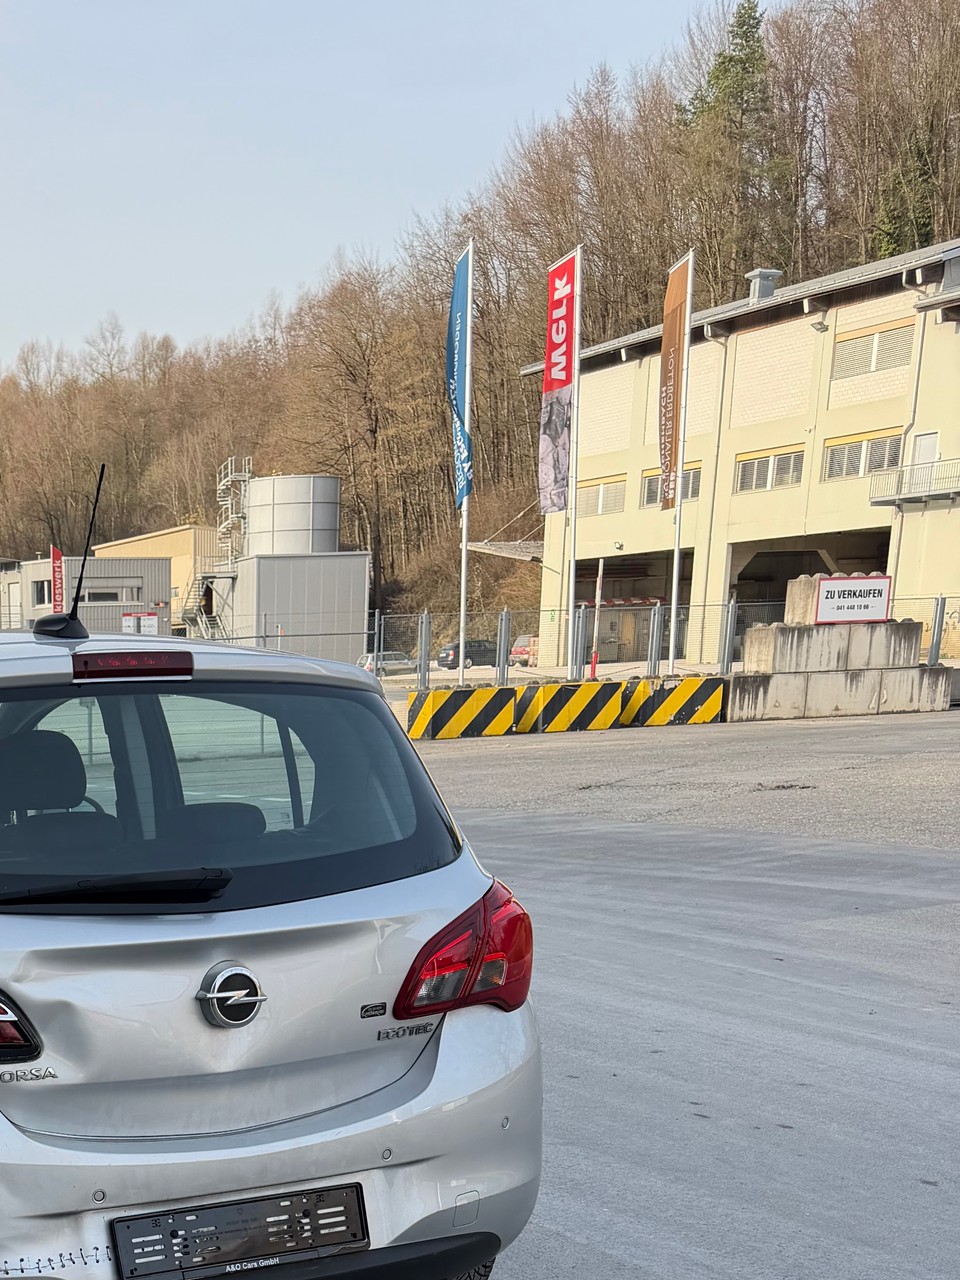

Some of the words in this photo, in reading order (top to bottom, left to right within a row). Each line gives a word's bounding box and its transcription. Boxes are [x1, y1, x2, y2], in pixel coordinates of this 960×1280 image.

[825, 590, 835, 600] ZU
[837, 588, 883, 599] VERKAUFEN
[225, 1264, 242, 1273] A&O
[242, 1262, 258, 1270] Cars
[258, 1257, 280, 1267] GmbH
